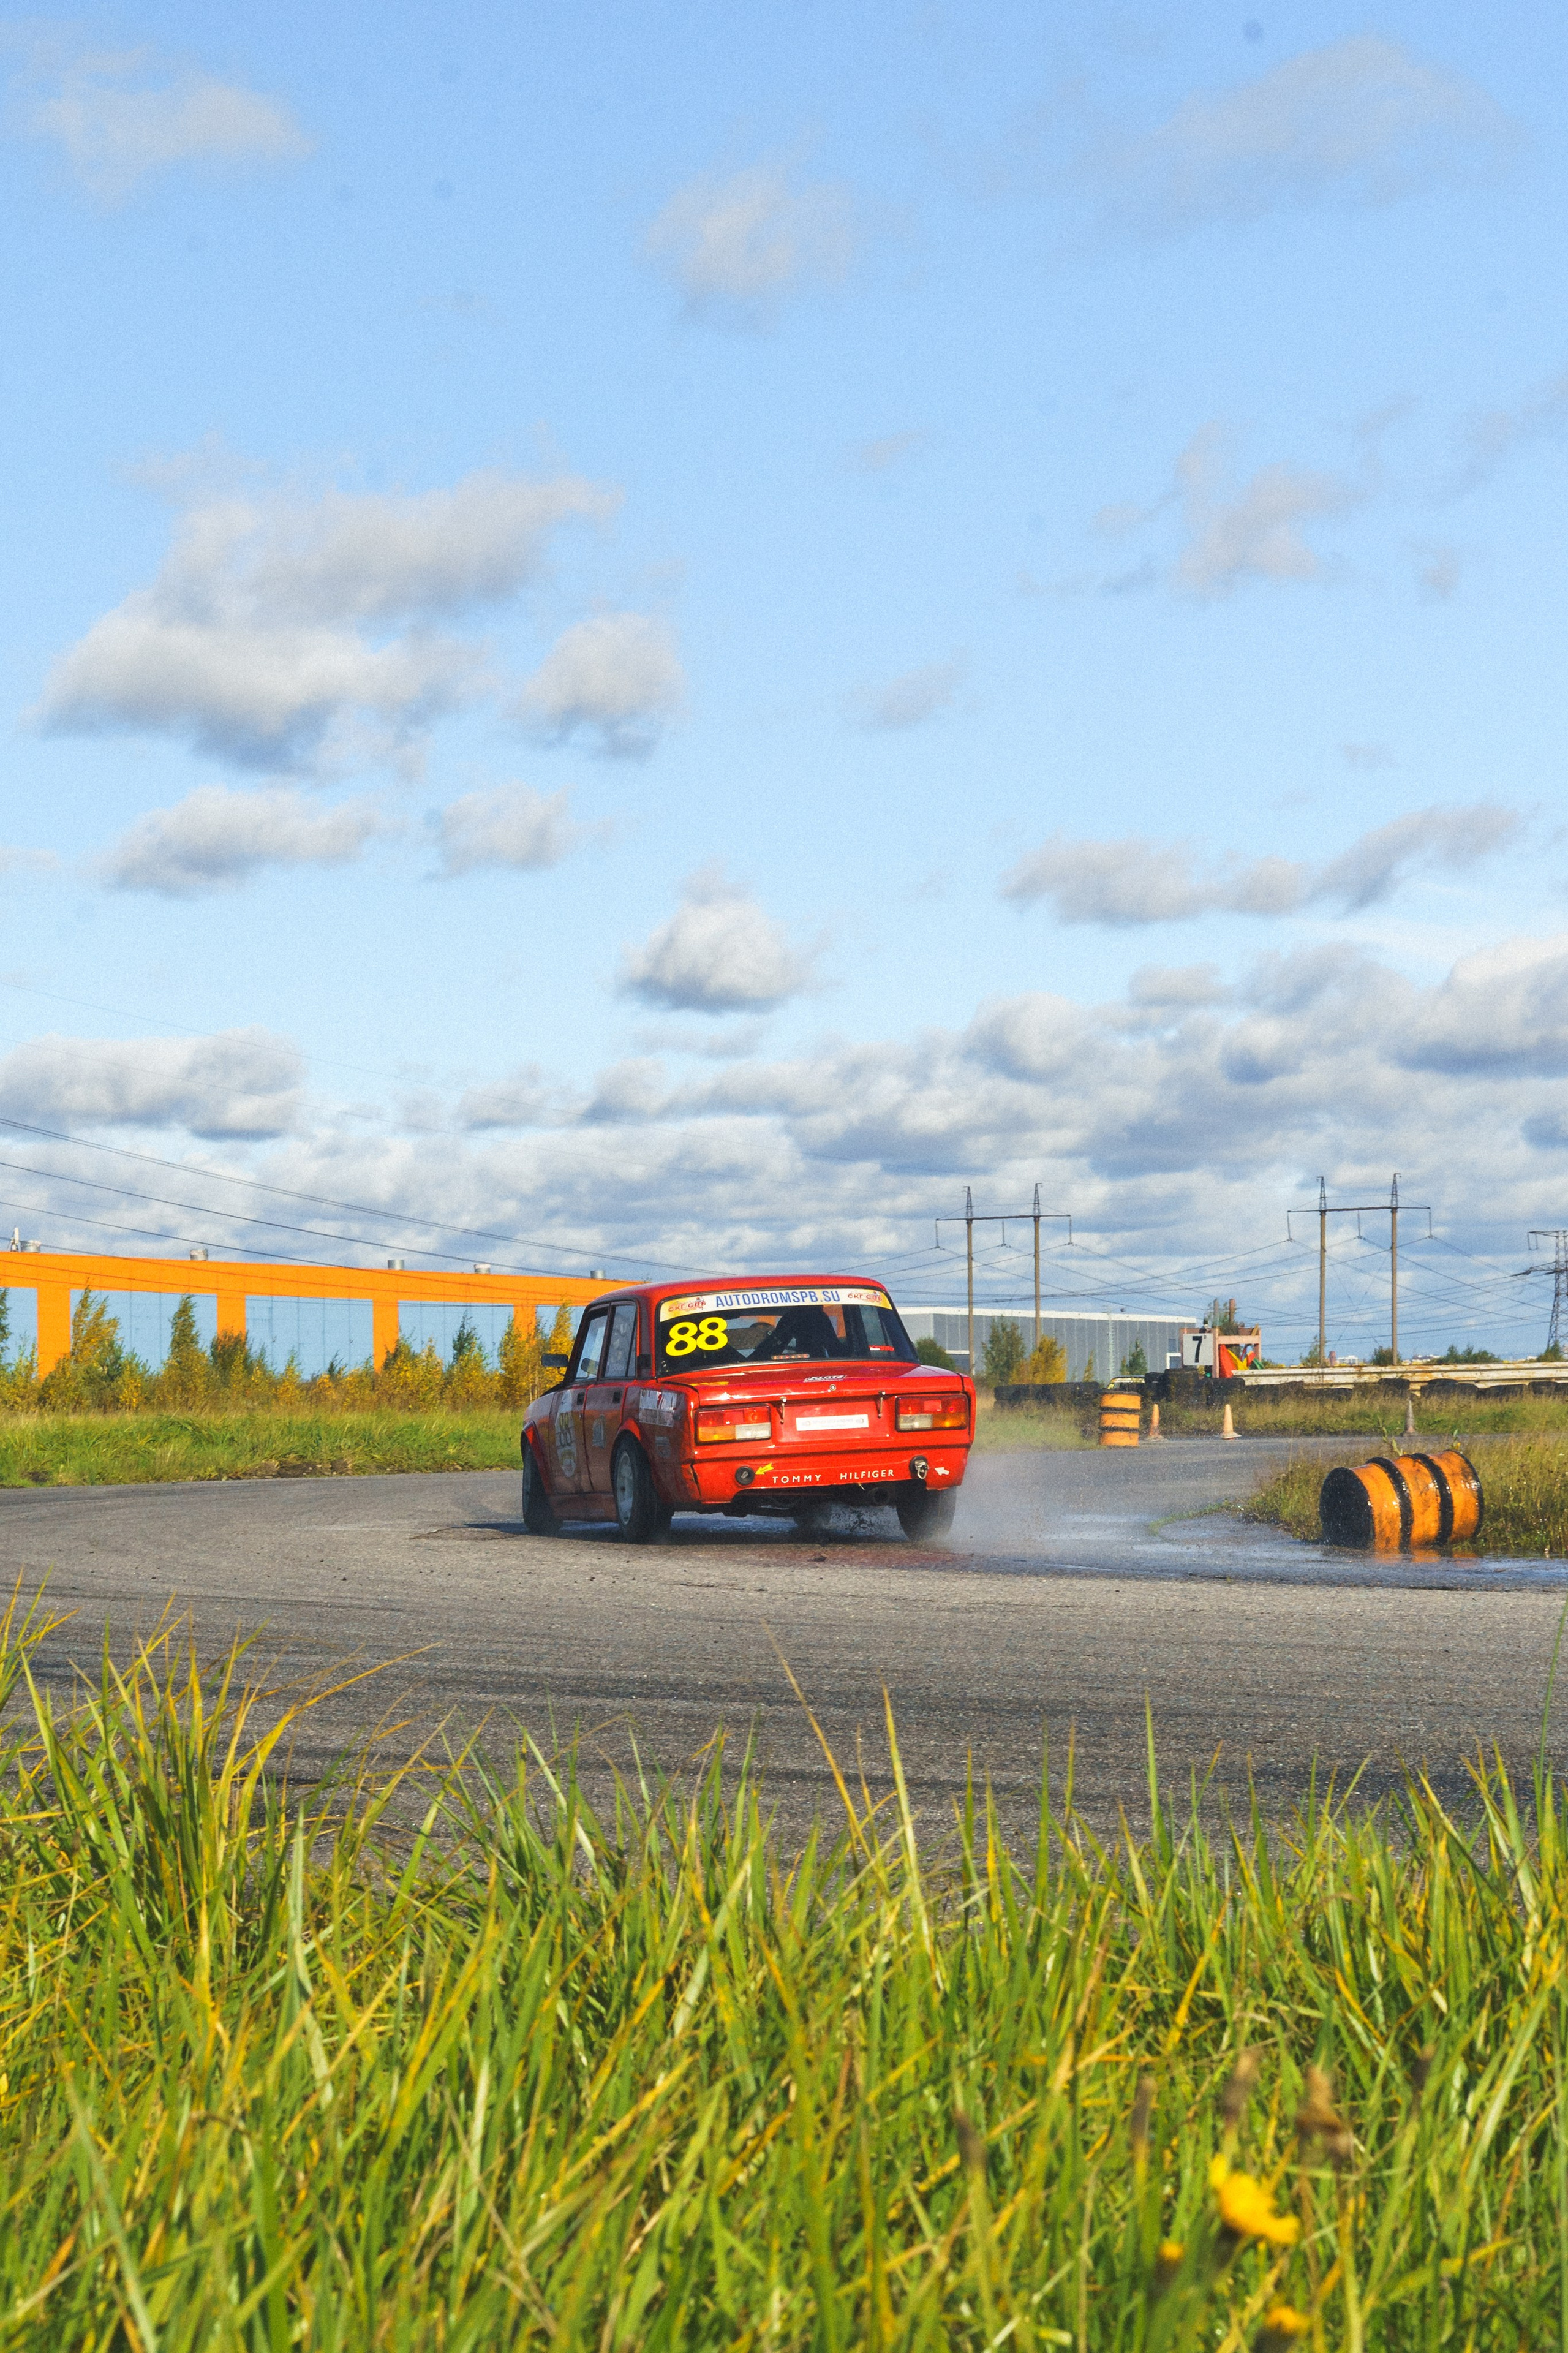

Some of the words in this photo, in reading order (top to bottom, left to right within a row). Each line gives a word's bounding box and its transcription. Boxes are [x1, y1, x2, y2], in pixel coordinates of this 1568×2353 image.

[716, 1290, 840, 1307] AUTODROMSPB.SU
[666, 1317, 728, 1356] 88
[1192, 1336, 1202, 1363] 7
[772, 1475, 821, 1484] TOMMY
[840, 1469, 894, 1480] HILFIGER
